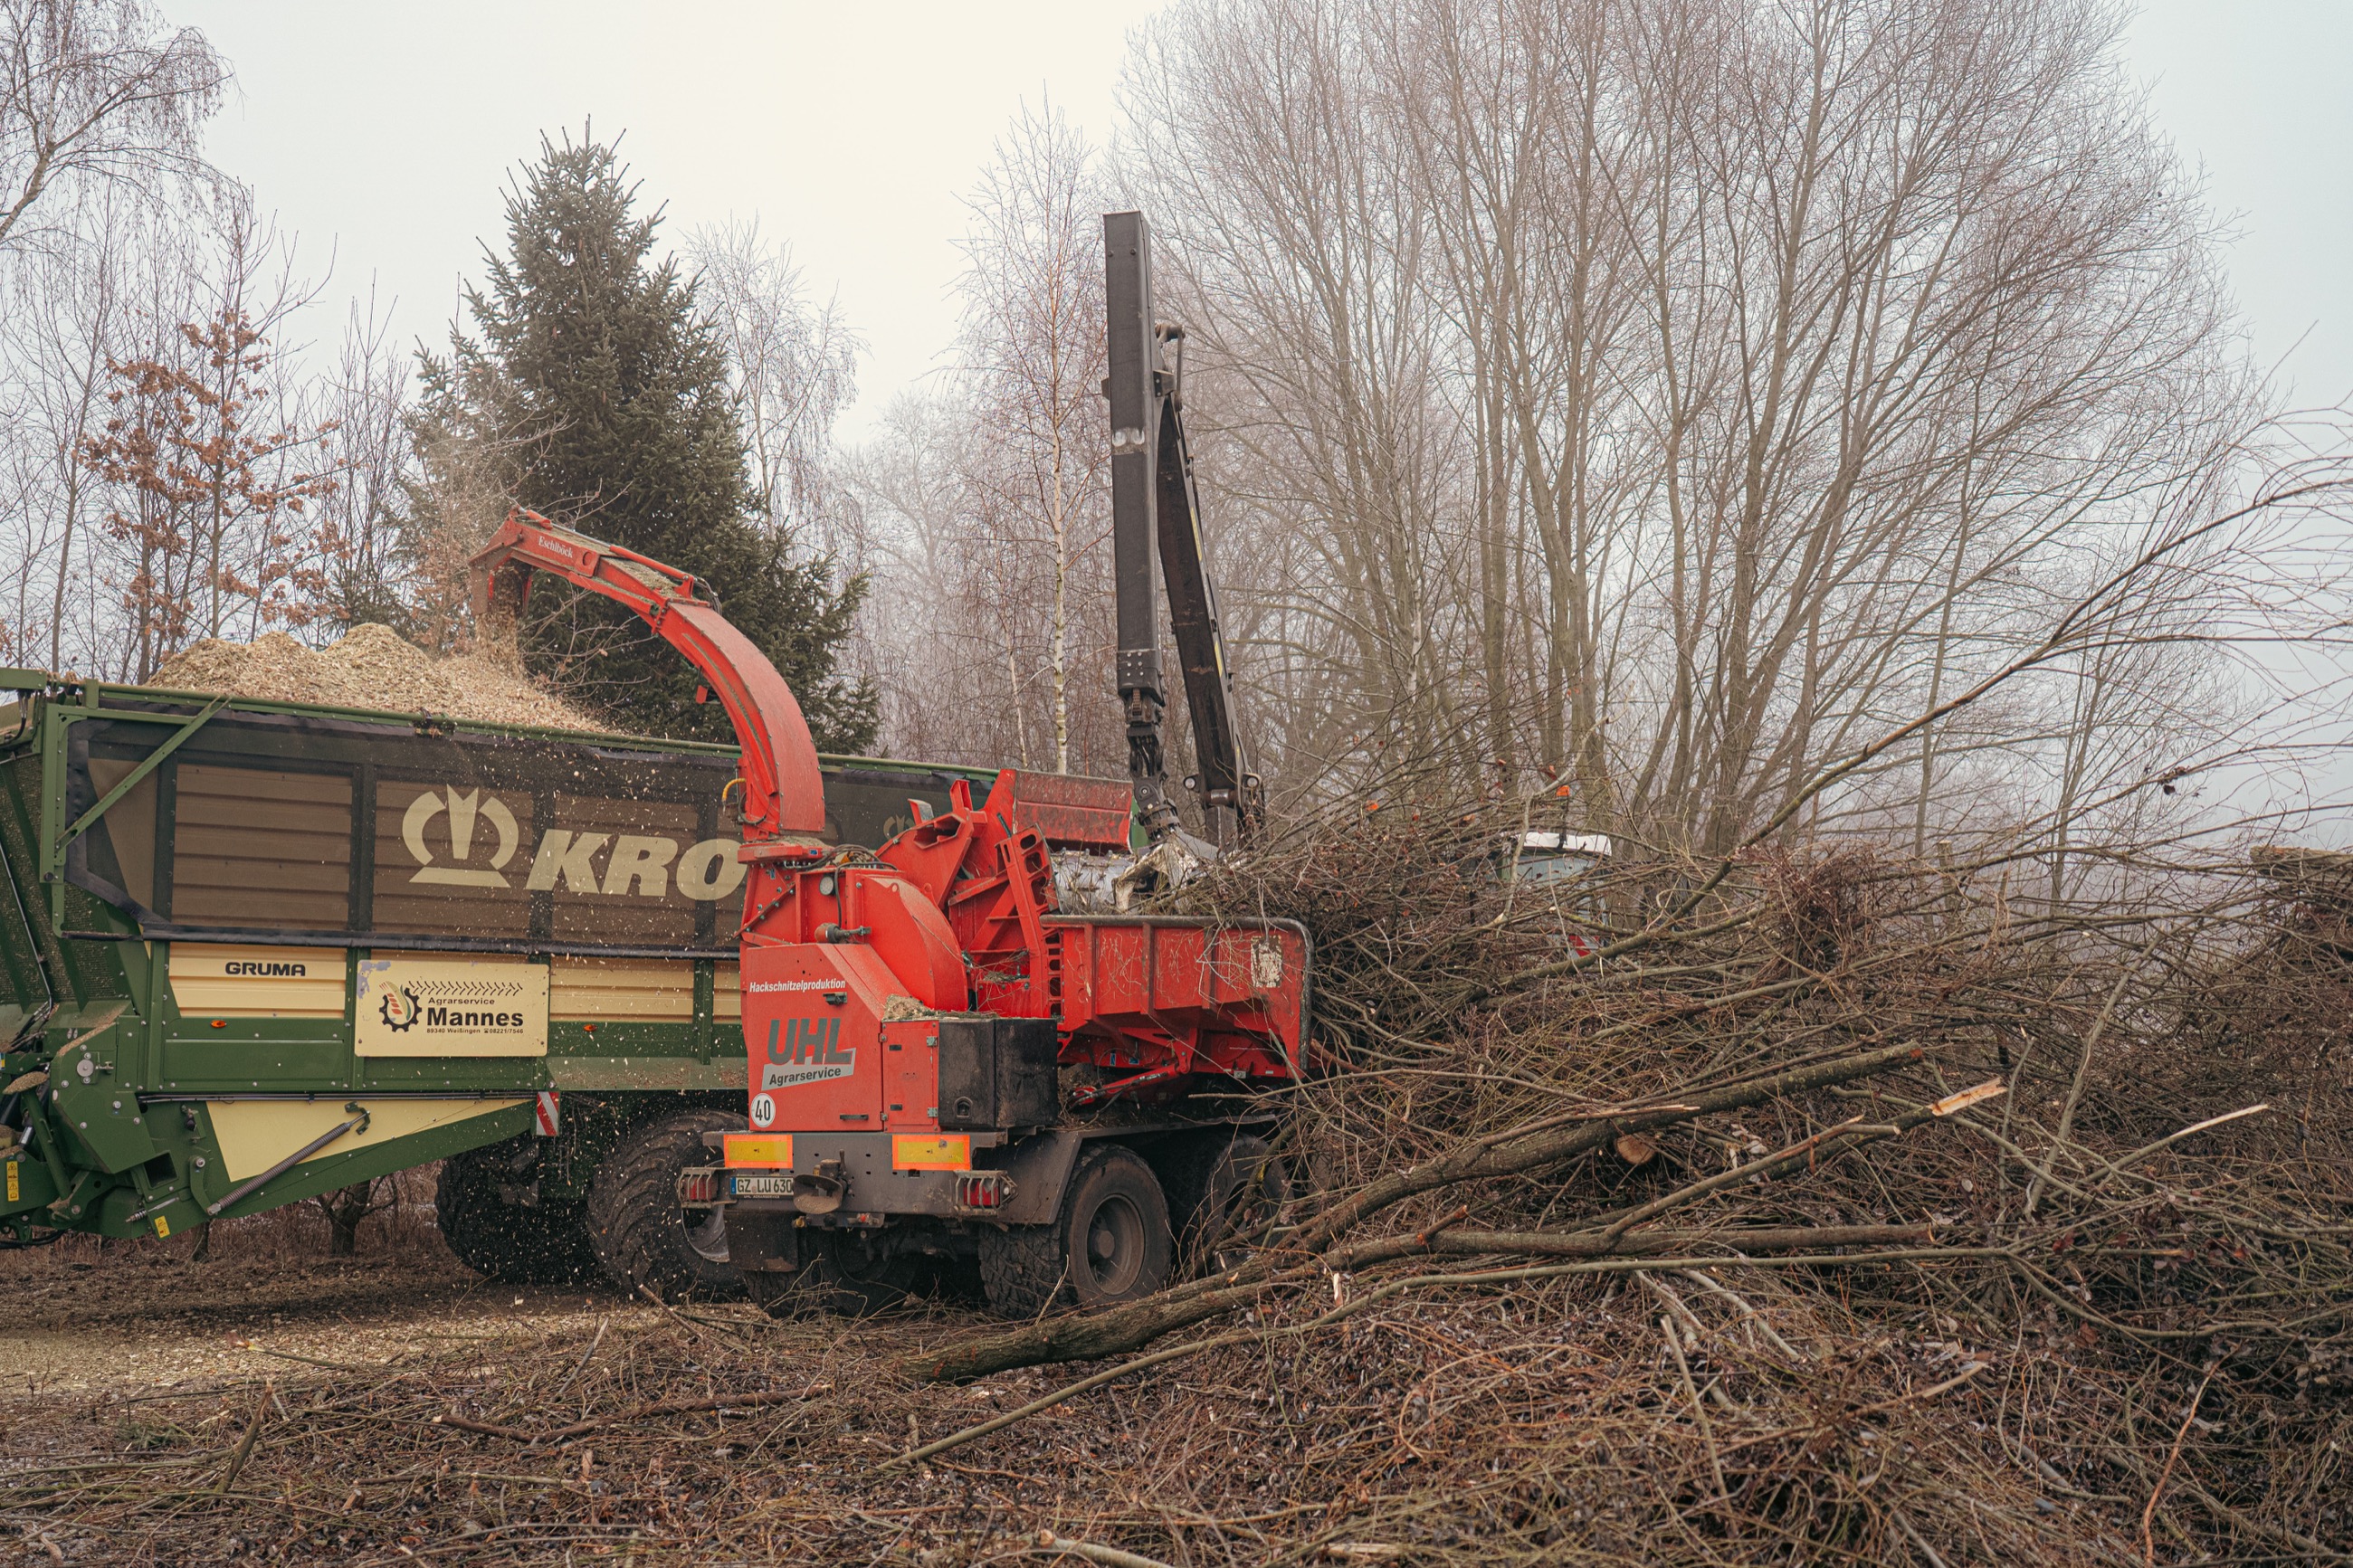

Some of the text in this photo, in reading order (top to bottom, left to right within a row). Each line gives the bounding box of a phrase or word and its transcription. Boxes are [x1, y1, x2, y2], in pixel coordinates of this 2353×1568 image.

[538, 536, 573, 558] Eschlböck
[224, 962, 306, 976] GRUMA
[749, 979, 846, 993] Hackschnitzelproduktion
[428, 997, 495, 1005] Agrarservice
[427, 1007, 523, 1026] Mannes
[767, 1018, 853, 1066] UHL
[769, 1067, 842, 1087] Agrarservice
[755, 1099, 771, 1121] 40
[738, 1179, 751, 1193] GZ
[757, 1179, 771, 1193] LU
